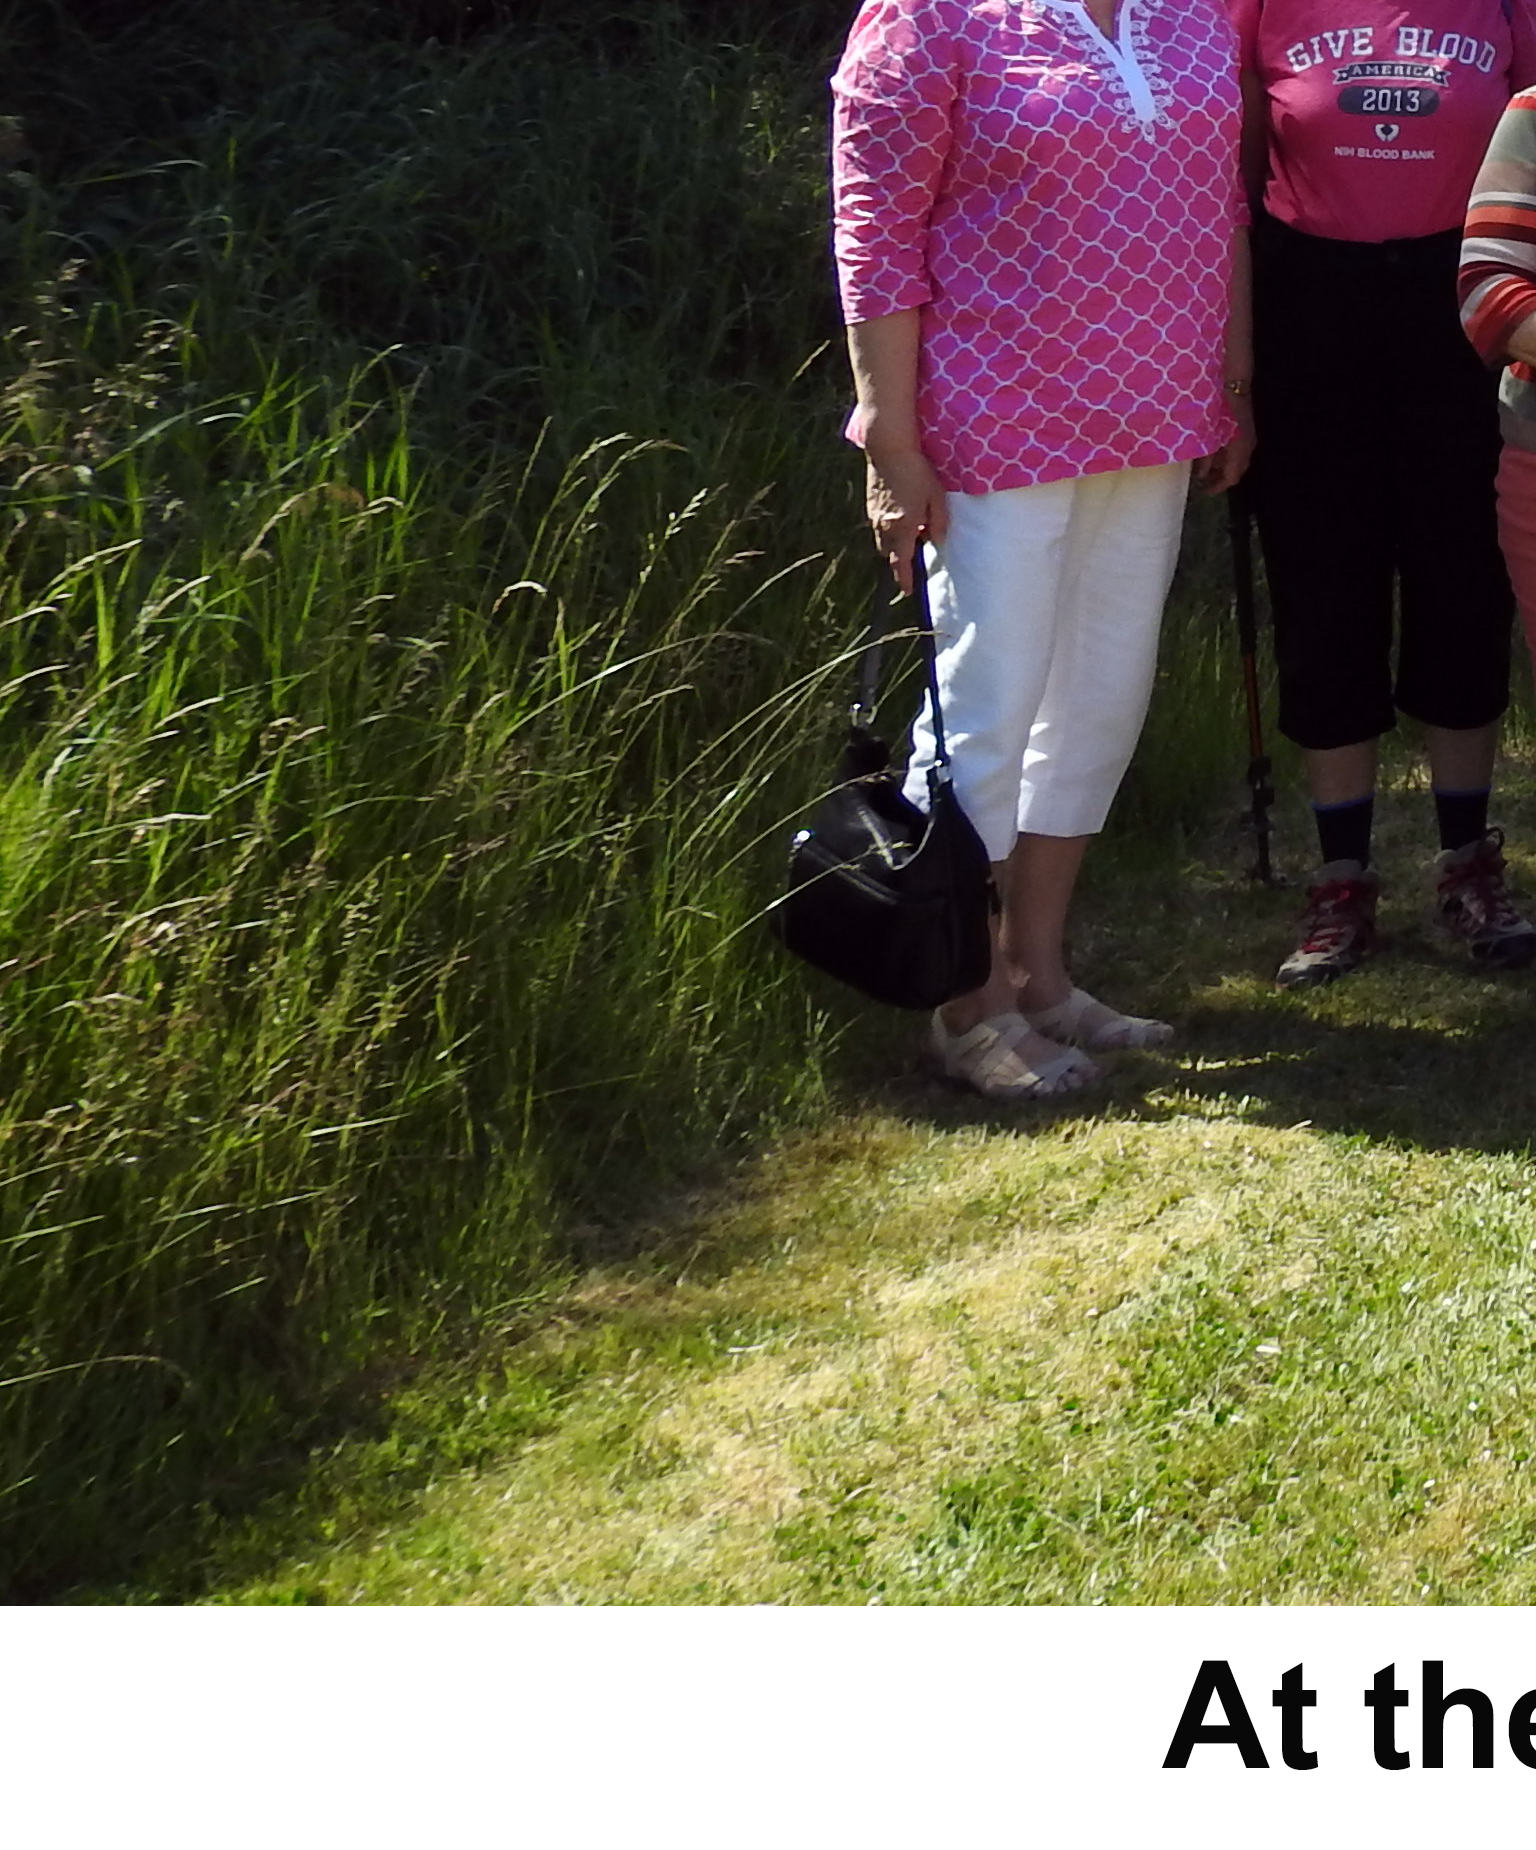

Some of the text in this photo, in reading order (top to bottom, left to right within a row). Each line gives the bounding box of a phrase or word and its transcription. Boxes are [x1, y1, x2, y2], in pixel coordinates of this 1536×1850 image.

[1286, 27, 1496, 73] GIVE BLOOD
[1351, 64, 1436, 78] AMERICA
[1362, 88, 1421, 112] 2013
[1357, 147, 1400, 160] BLOOD
[1401, 149, 1435, 160] BANK
